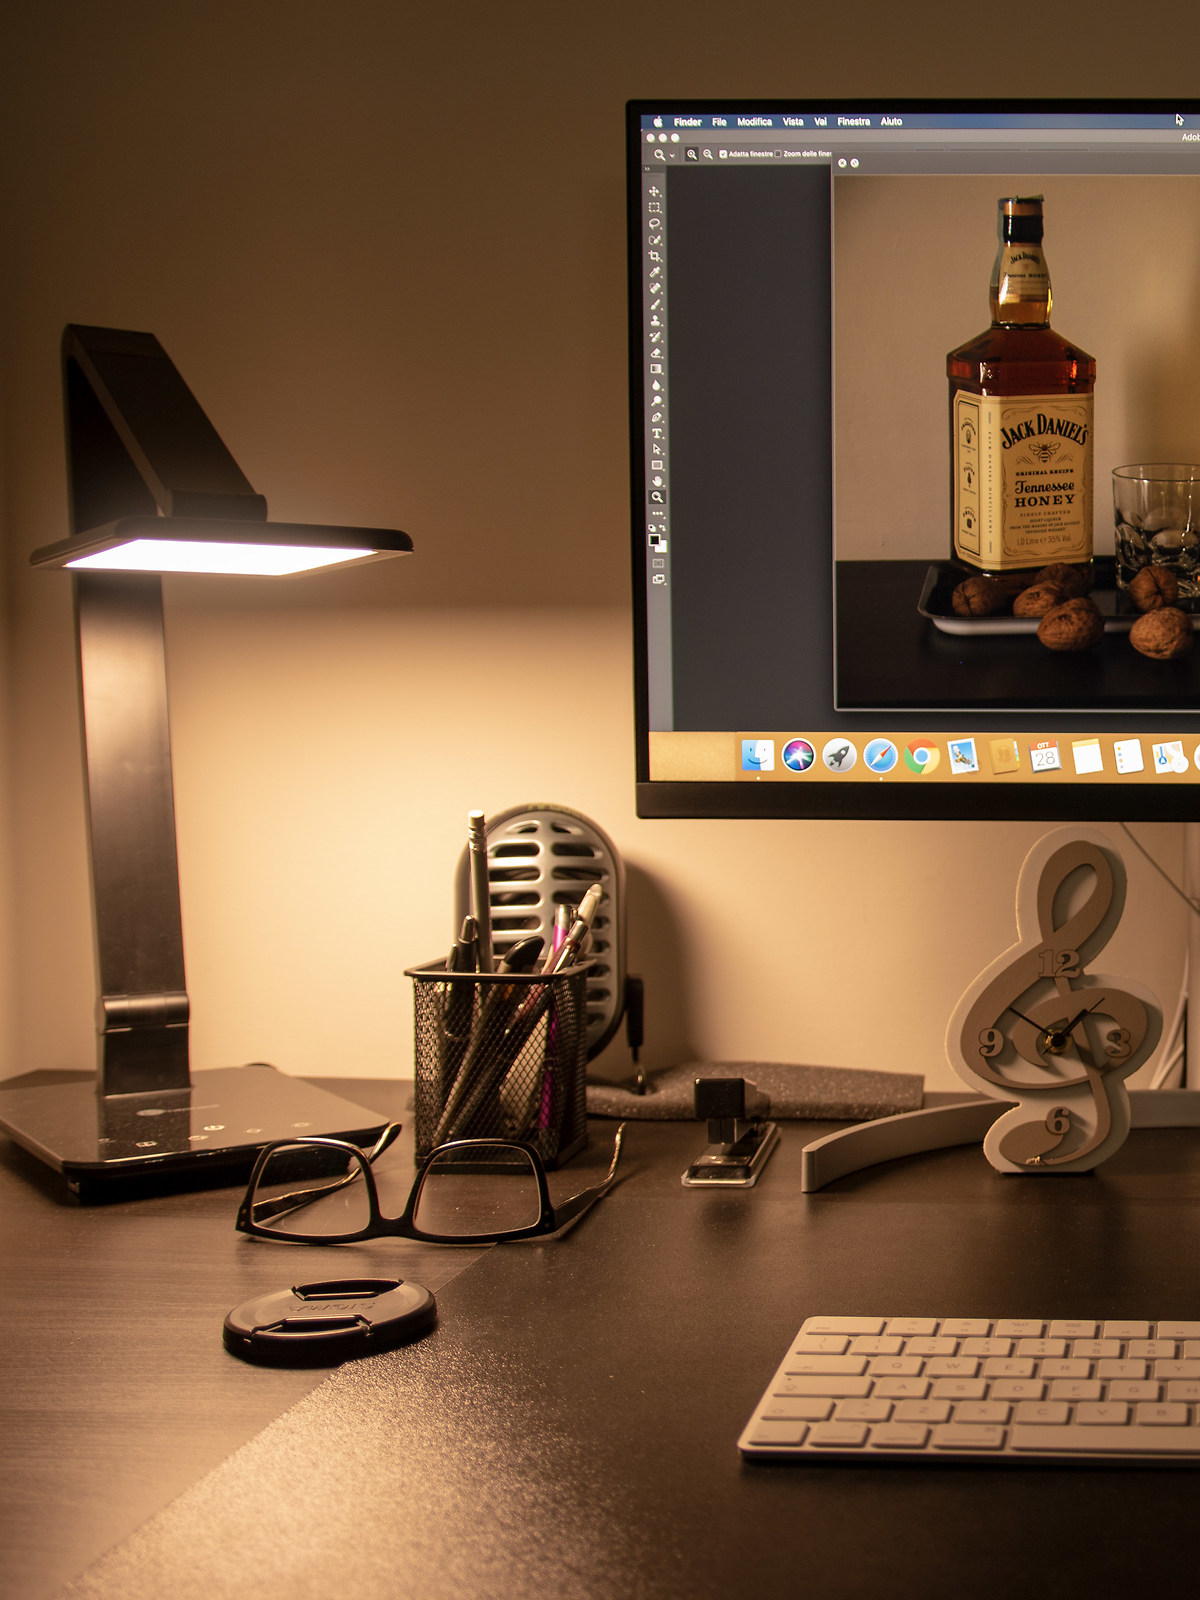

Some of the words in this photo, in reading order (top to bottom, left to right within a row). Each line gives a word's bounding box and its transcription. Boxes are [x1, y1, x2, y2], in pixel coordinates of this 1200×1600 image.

[674, 117, 702, 127] Finder
[712, 117, 727, 127] File
[737, 117, 773, 127] Modifica
[782, 117, 804, 126] Vista
[814, 117, 828, 126] Vai
[837, 117, 871, 126] Finestra
[880, 117, 903, 126] Aiuto
[1000, 420, 1036, 449] JACK
[1036, 413, 1089, 445] DANIEL'S
[1015, 480, 1075, 494] Tennessee
[1014, 494, 1075, 508] HONEY
[1037, 741, 1049, 749] OTT
[1035, 751, 1055, 766] 28
[1038, 949, 1082, 978] 12
[978, 1027, 1004, 1057] 9
[1104, 1028, 1133, 1058] 3
[1045, 1106, 1070, 1135] 6
